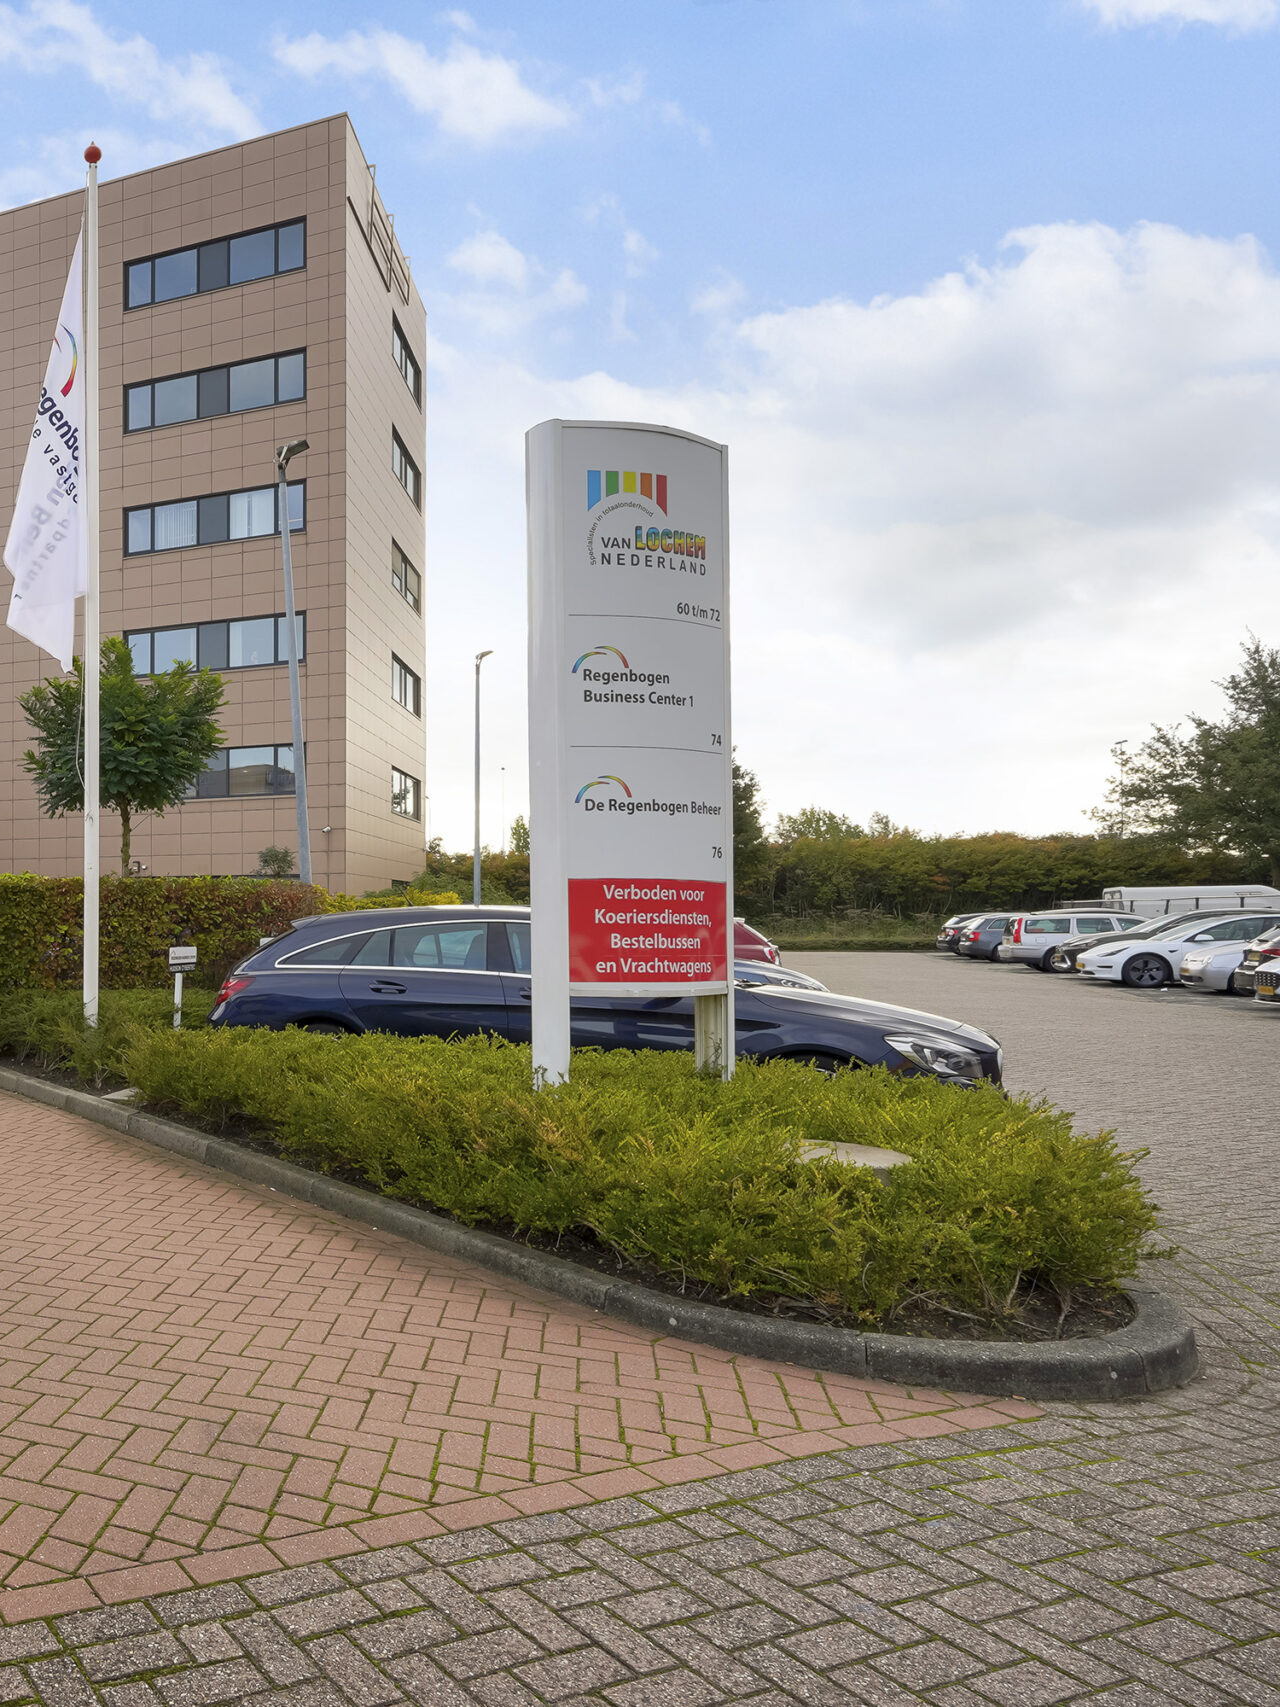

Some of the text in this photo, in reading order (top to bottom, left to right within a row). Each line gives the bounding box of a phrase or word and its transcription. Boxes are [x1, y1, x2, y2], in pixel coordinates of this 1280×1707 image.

[587, 501, 654, 566] Specialisten in totaalonderhoud
[601, 525, 706, 560] VAN LOCHEM
[601, 553, 706, 576] NEDERLAND
[677, 602, 721, 622] 60 t/m 72
[583, 668, 670, 686] Regenbogen
[583, 690, 695, 707] Business Center 1
[711, 734, 722, 747] 74
[584, 799, 722, 816] De Regenbogen Beheer
[712, 846, 723, 859] 76
[603, 885, 705, 902] Verboden voor
[594, 909, 712, 928] Koeriersdiensten,
[610, 933, 701, 949] Bestelbussen
[596, 957, 712, 977] en Vrachtwagens
